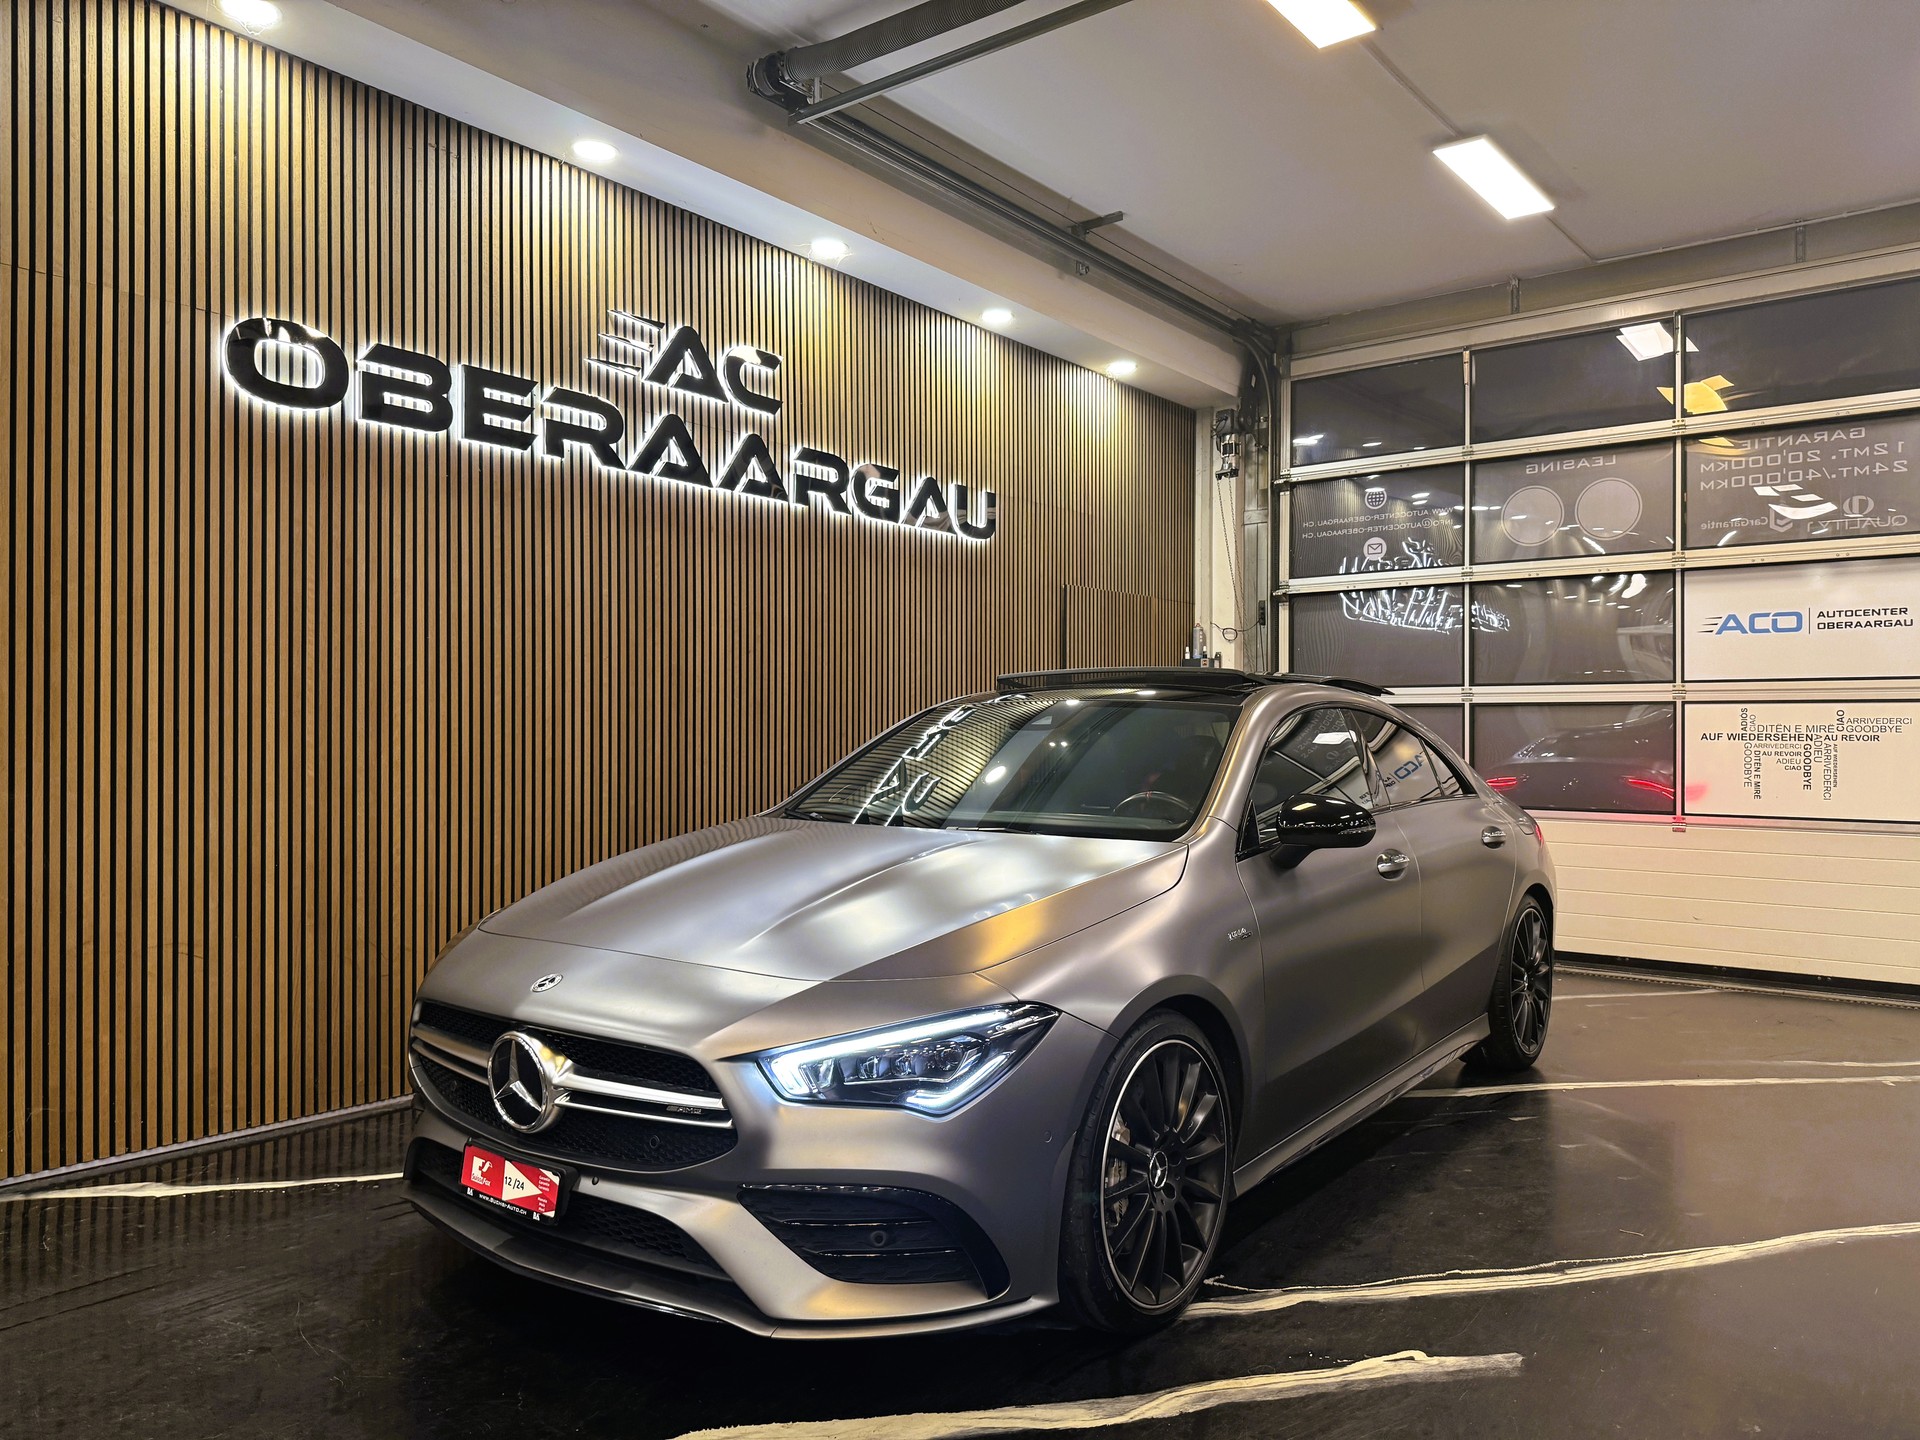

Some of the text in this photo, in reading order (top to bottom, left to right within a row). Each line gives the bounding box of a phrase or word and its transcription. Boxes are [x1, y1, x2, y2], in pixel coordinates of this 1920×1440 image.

[221, 316, 997, 541] OBERAARGAU
[1816, 607, 1909, 619] AUTOCENTER
[1714, 611, 1804, 635] ACO
[1816, 618, 1914, 630] OBERAARGAU
[1794, 724, 1802, 733] E
[1836, 709, 1845, 732] CIAO
[1846, 717, 1913, 725] ARRIVEDERCI
[1700, 733, 1814, 742] AUF WIEDERSEHEN
[1823, 734, 1880, 742] AU REVOIR
[1845, 725, 1903, 734] GOODBYE
[1813, 733, 1823, 764] ADIEU
[1743, 742, 1752, 788] GOODBYE
[1803, 743, 1812, 790] GOODBYE
[1823, 742, 1832, 801] ARRIVEDERCI
